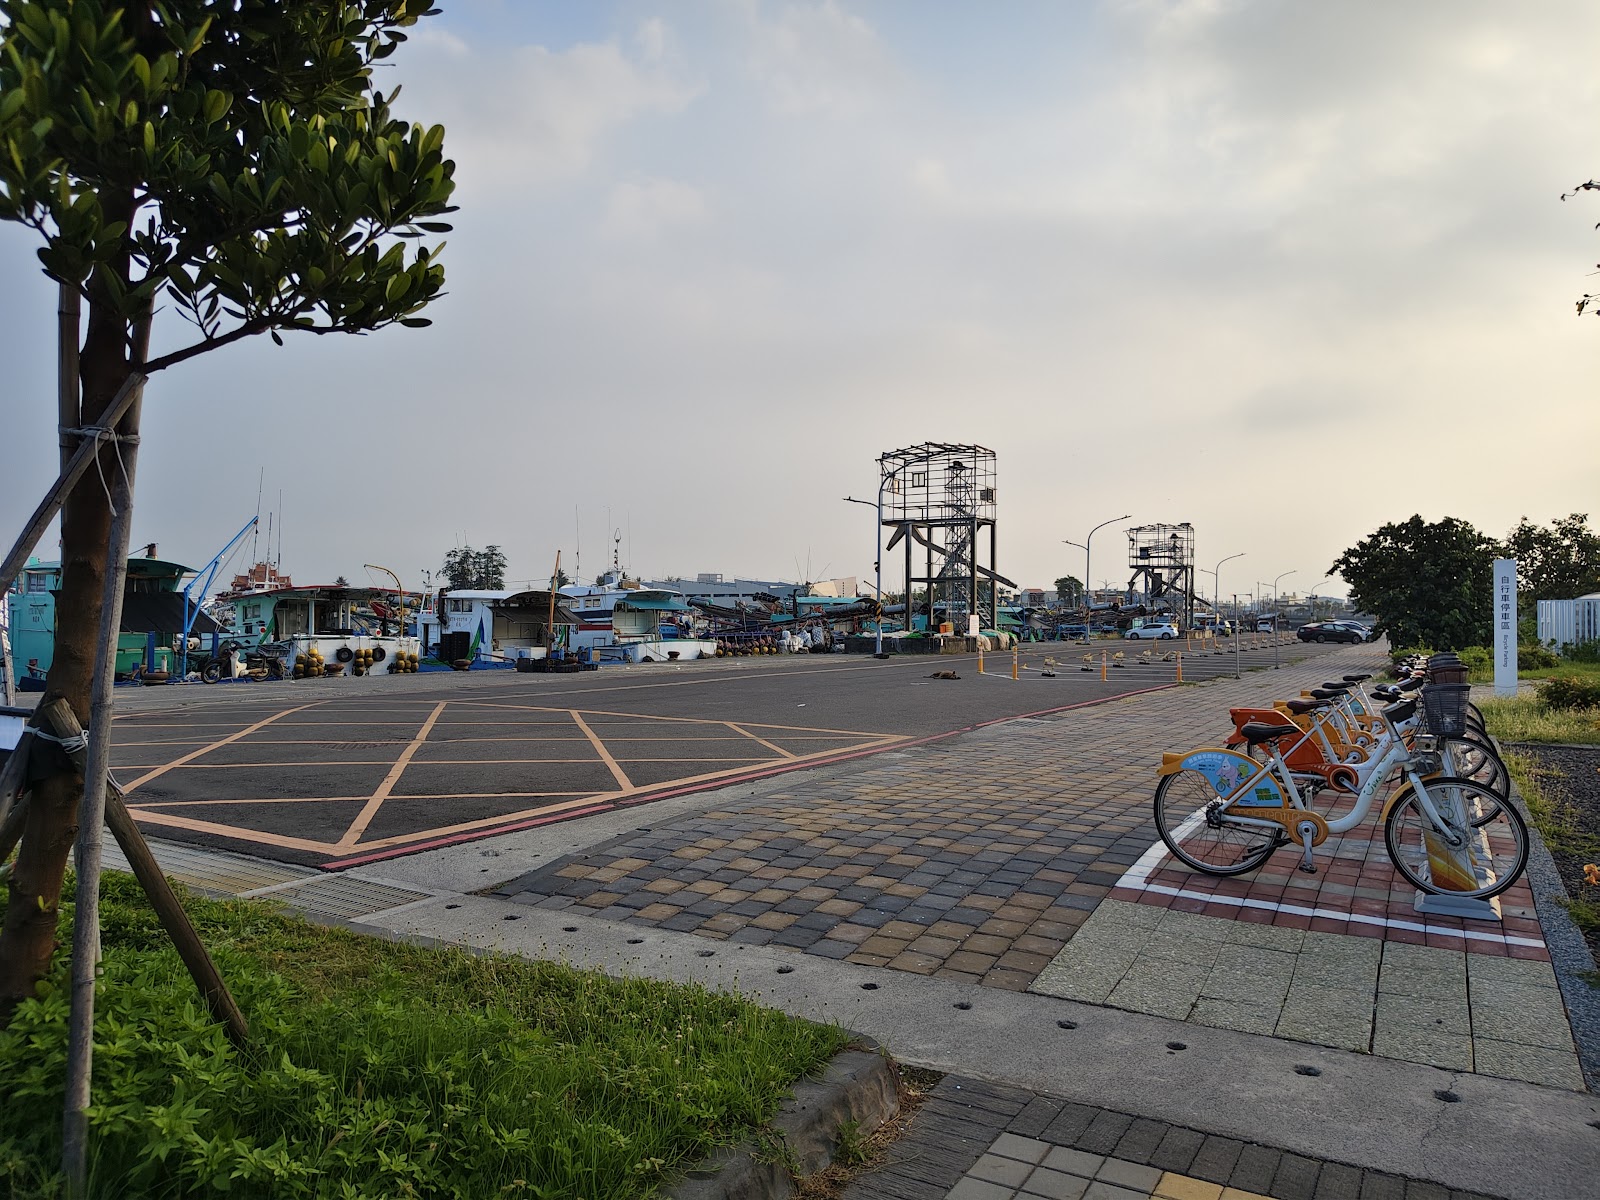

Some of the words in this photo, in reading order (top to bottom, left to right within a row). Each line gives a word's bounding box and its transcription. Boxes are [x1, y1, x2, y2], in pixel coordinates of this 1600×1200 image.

[1500, 575, 1510, 630] 自行車停車區
